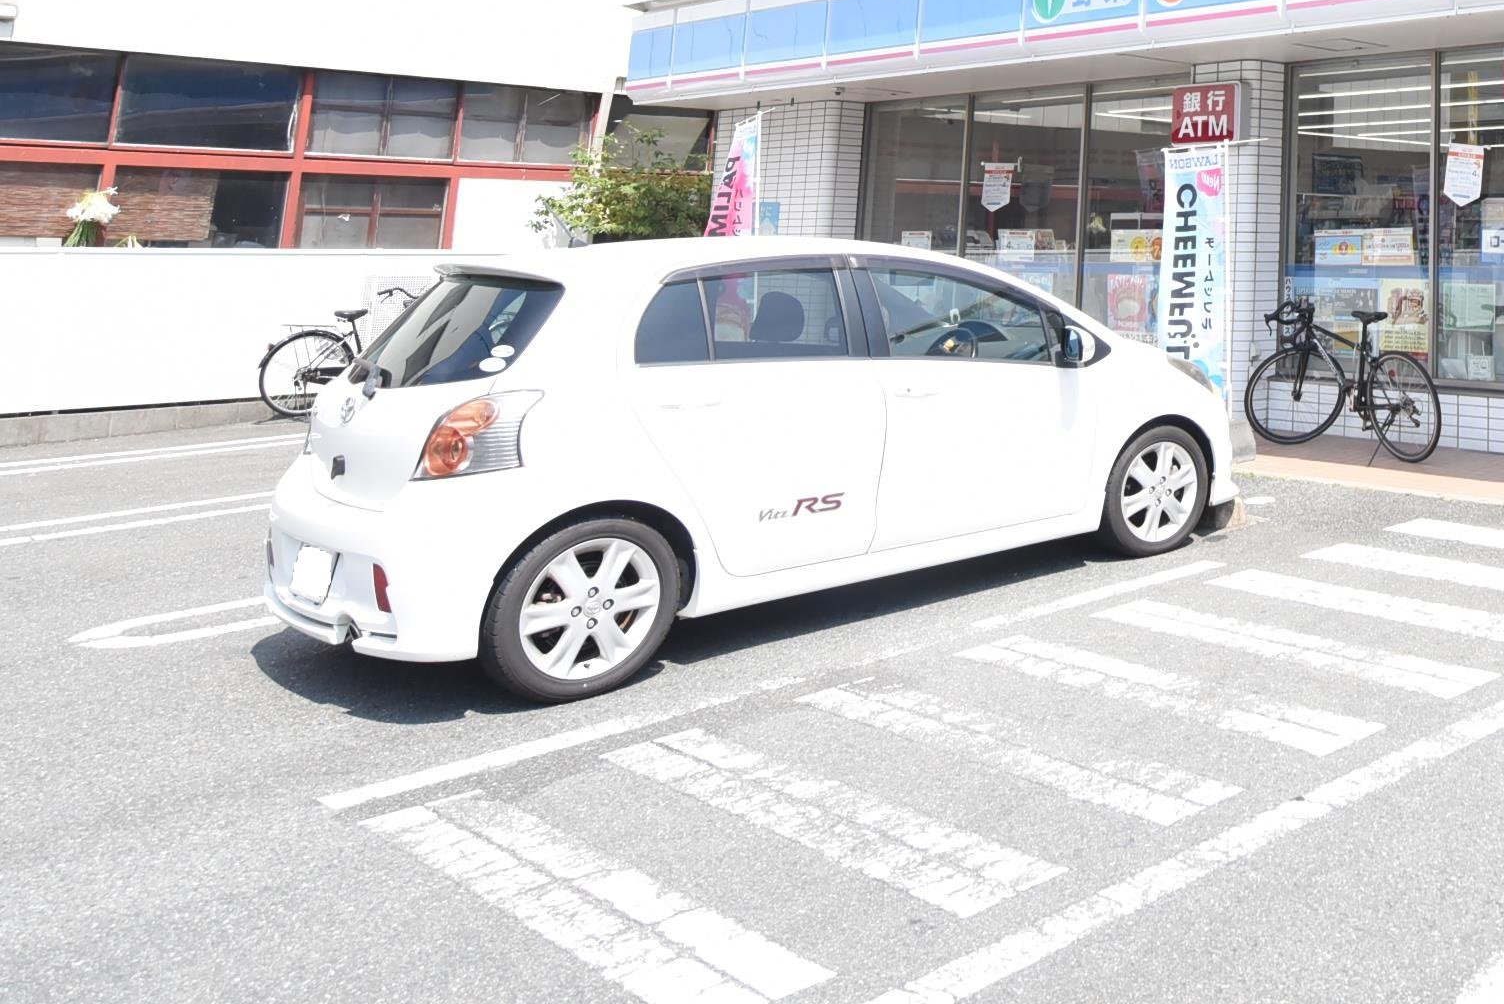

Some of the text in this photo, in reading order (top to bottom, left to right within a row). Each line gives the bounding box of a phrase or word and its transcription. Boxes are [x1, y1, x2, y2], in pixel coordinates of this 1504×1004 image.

[1182, 90, 1226, 113] 銀行
[1177, 114, 1228, 139] ATM
[791, 492, 846, 517] RS
